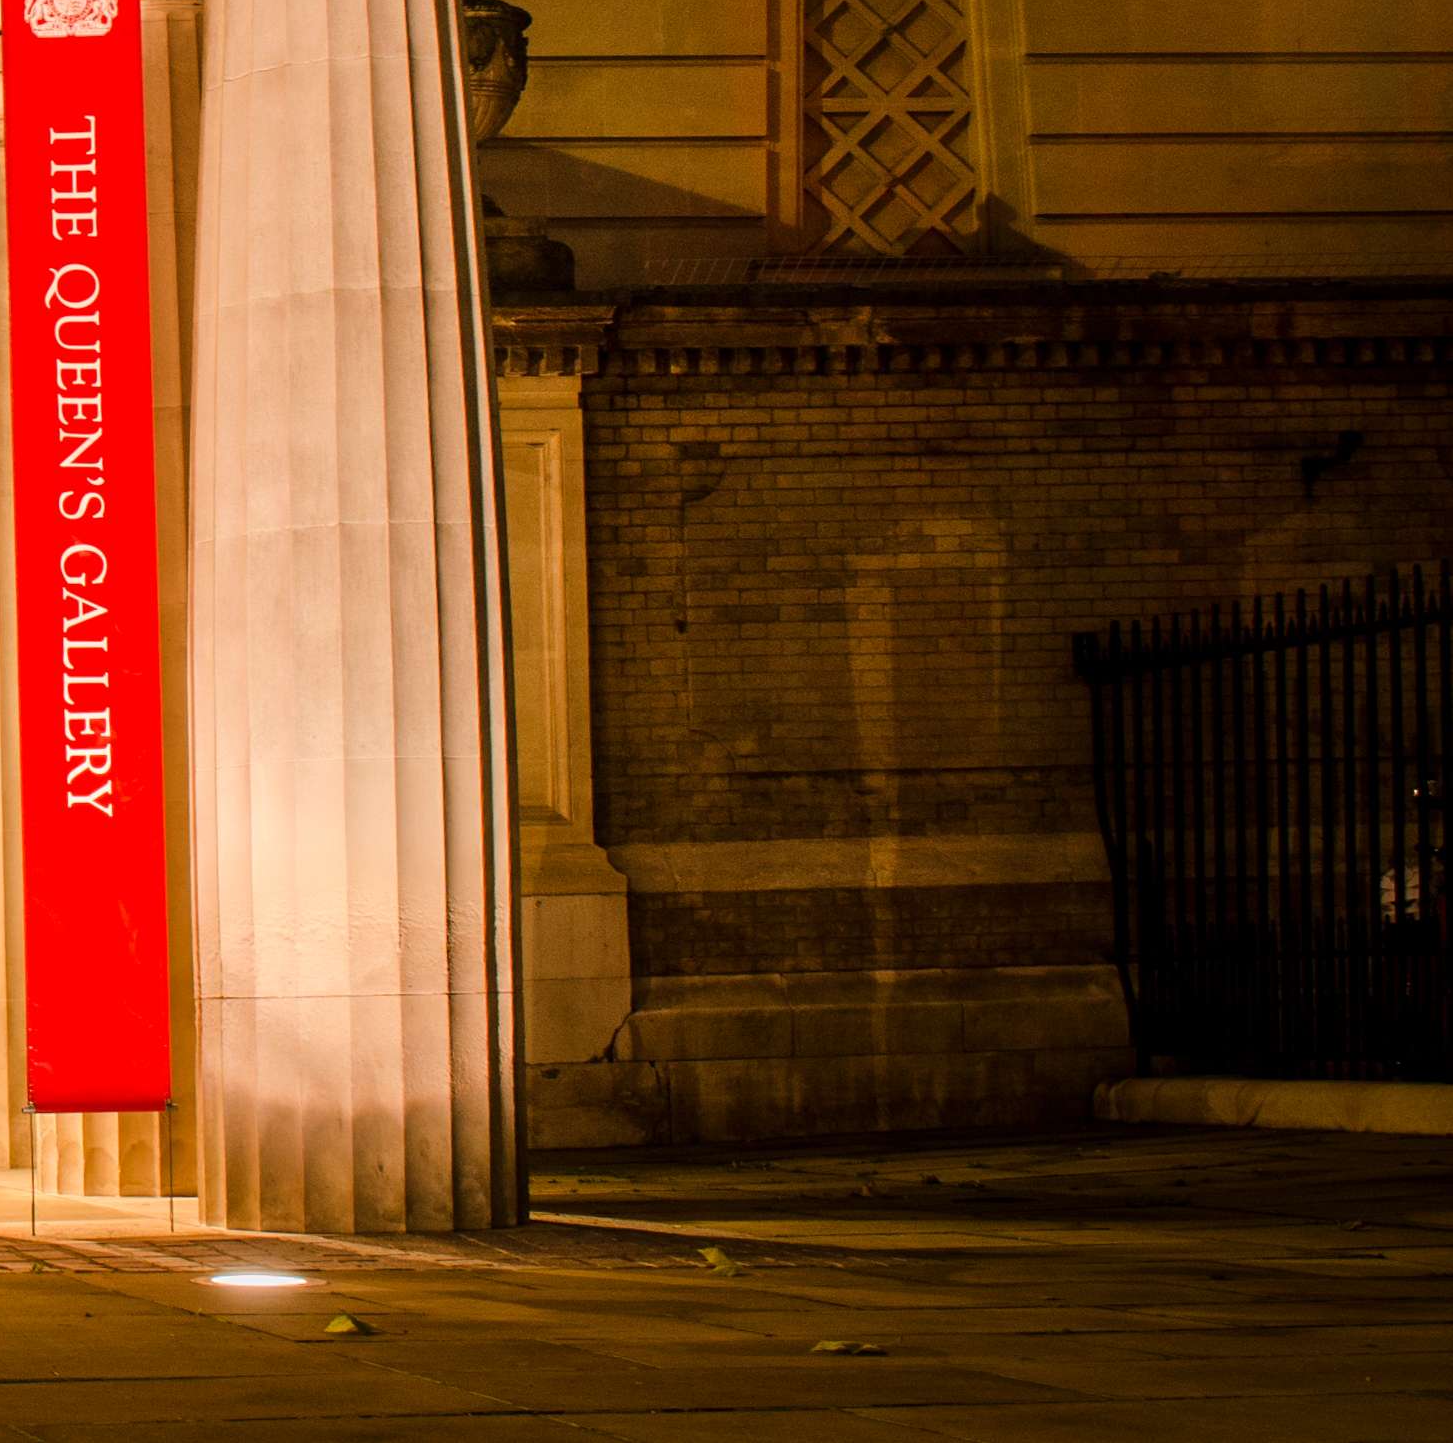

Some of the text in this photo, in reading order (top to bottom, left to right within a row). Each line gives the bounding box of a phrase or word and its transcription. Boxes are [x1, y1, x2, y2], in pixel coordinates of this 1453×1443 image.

[44, 115, 113, 818] THE QUEEN'S GALLERY
